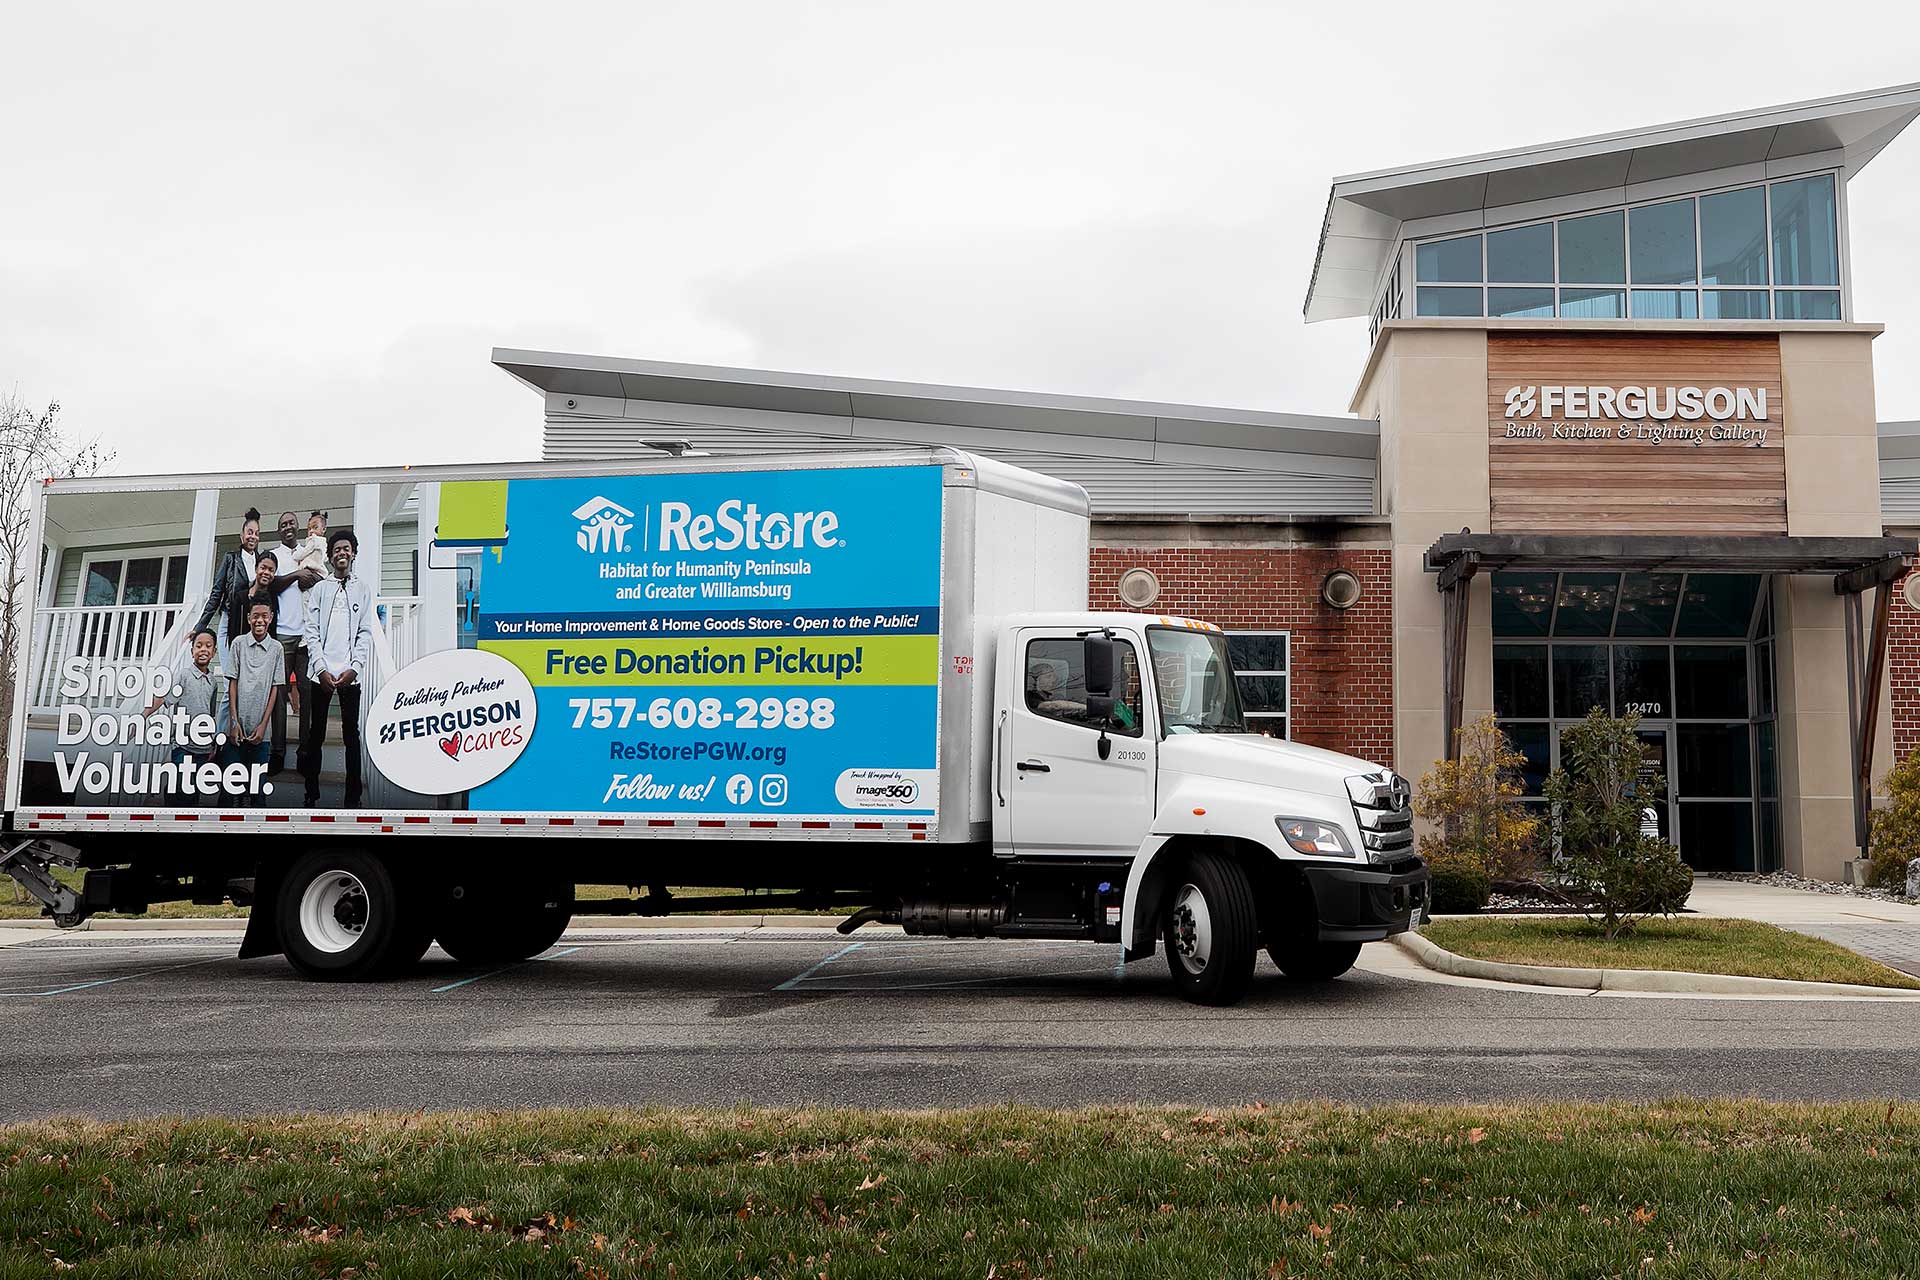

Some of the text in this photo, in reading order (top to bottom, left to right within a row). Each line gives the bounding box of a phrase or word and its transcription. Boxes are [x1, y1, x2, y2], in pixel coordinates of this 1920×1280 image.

[1541, 386, 1768, 420] FERGUSON
[1505, 423, 1767, 443] Bath, Kitchen & Lighting Gallery
[599, 559, 811, 579] Habitat for Humanity Peninsula
[616, 581, 792, 600] and Greater Williamsburg
[495, 620, 522, 633] Your
[525, 620, 562, 632] Home
[565, 619, 647, 634] Improvement
[649, 618, 659, 631] &
[662, 618, 701, 631] Home
[703, 617, 745, 631] Goods
[748, 617, 783, 630] Store
[793, 616, 829, 631] Open
[832, 617, 846, 628] to
[849, 615, 870, 628] the
[873, 614, 919, 628] Public!
[546, 645, 863, 680] Free Donation Pickup!
[60, 656, 183, 707] Shop.
[393, 677, 505, 710] Building Partner
[399, 700, 521, 740] FERGUSON
[568, 697, 835, 729] 757-608-2988
[1625, 702, 1661, 713] 12470
[57, 704, 227, 746] Donate.
[463, 725, 523, 753] cares
[610, 741, 787, 765] ReStorePGW.org
[1118, 750, 1146, 760] 201300
[53, 751, 274, 795] Volunteer.
[850, 771, 866, 779] Truck
[894, 772, 902, 781] by
[602, 773, 717, 804] Follow us!
[856, 785, 912, 798] image360
